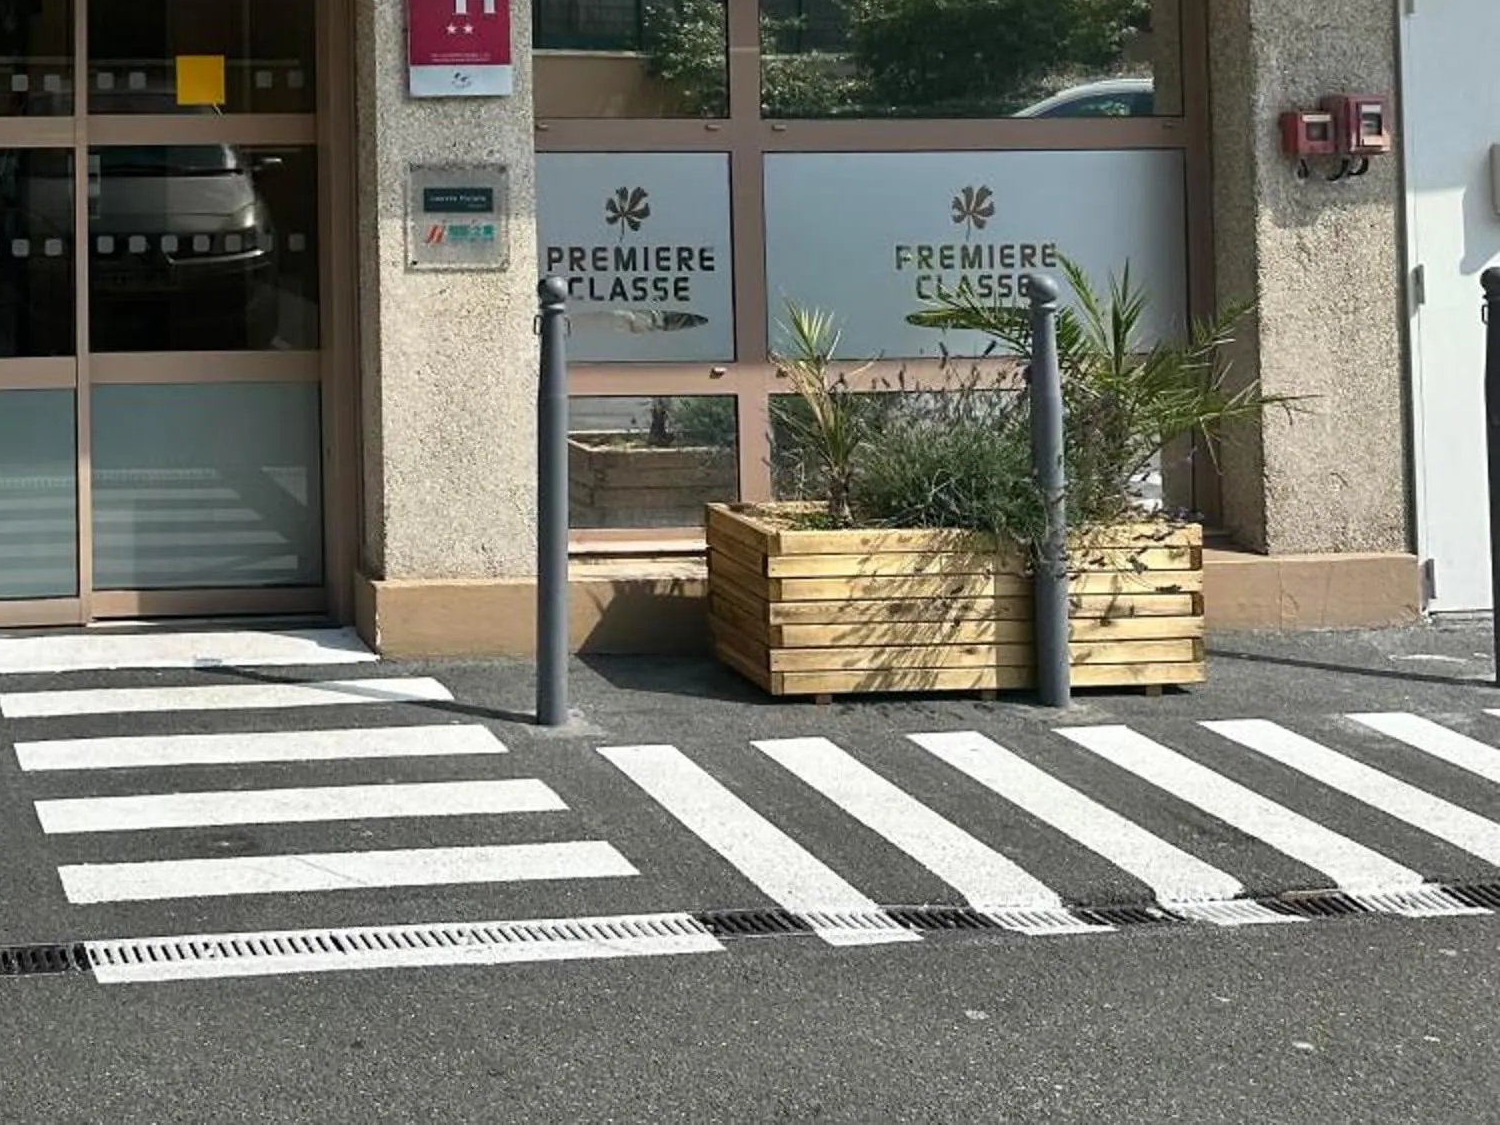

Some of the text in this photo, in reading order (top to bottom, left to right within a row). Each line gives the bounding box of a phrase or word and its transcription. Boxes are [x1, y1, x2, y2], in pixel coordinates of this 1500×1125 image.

[546, 246, 715, 272] PREMIERE
[895, 243, 1057, 270] PREMIERE
[567, 276, 691, 302] CLASSE
[916, 274, 1032, 299] CLASSE
